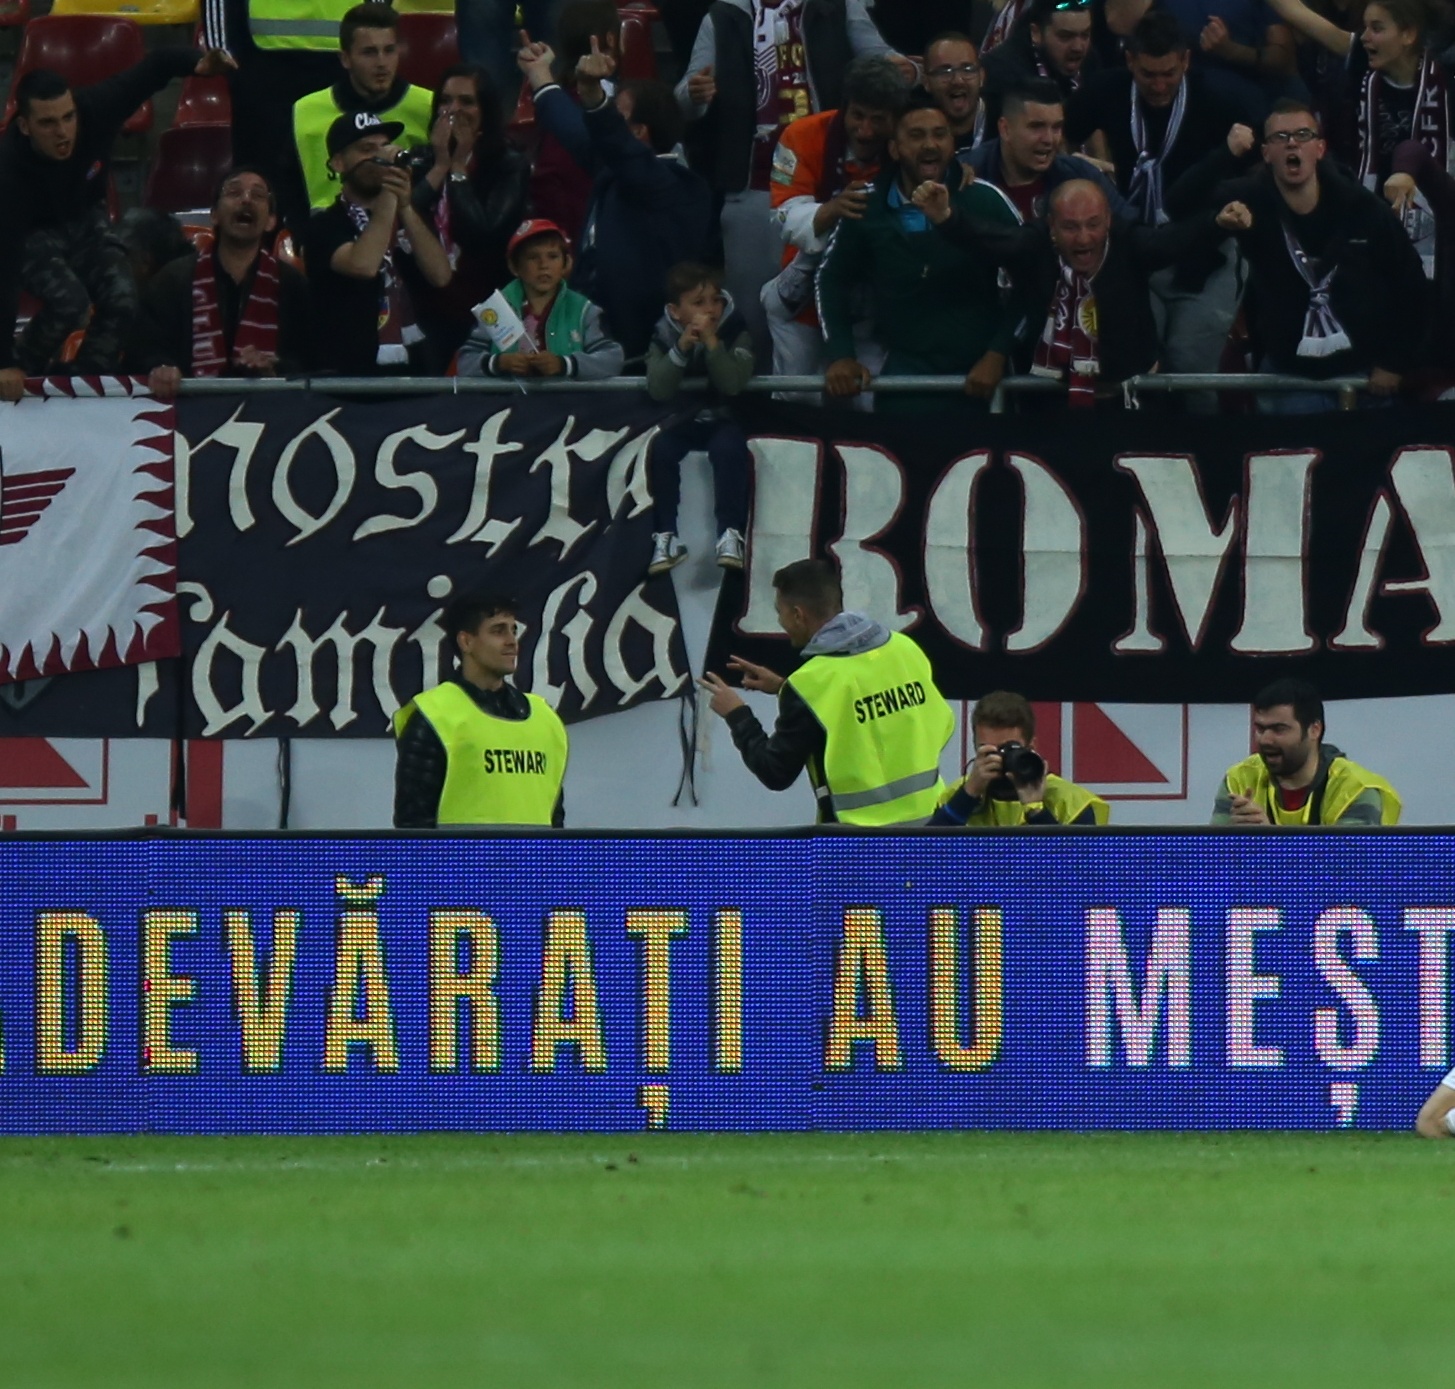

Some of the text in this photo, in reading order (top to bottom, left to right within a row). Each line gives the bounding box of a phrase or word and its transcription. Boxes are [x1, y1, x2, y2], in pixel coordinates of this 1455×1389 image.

[174, 402, 662, 559] nostra
[137, 569, 689, 737] familia
[855, 681, 926, 723] STEWARD
[0, 874, 745, 1129] DEVĂRAȚI
[823, 906, 1003, 1074] AU
